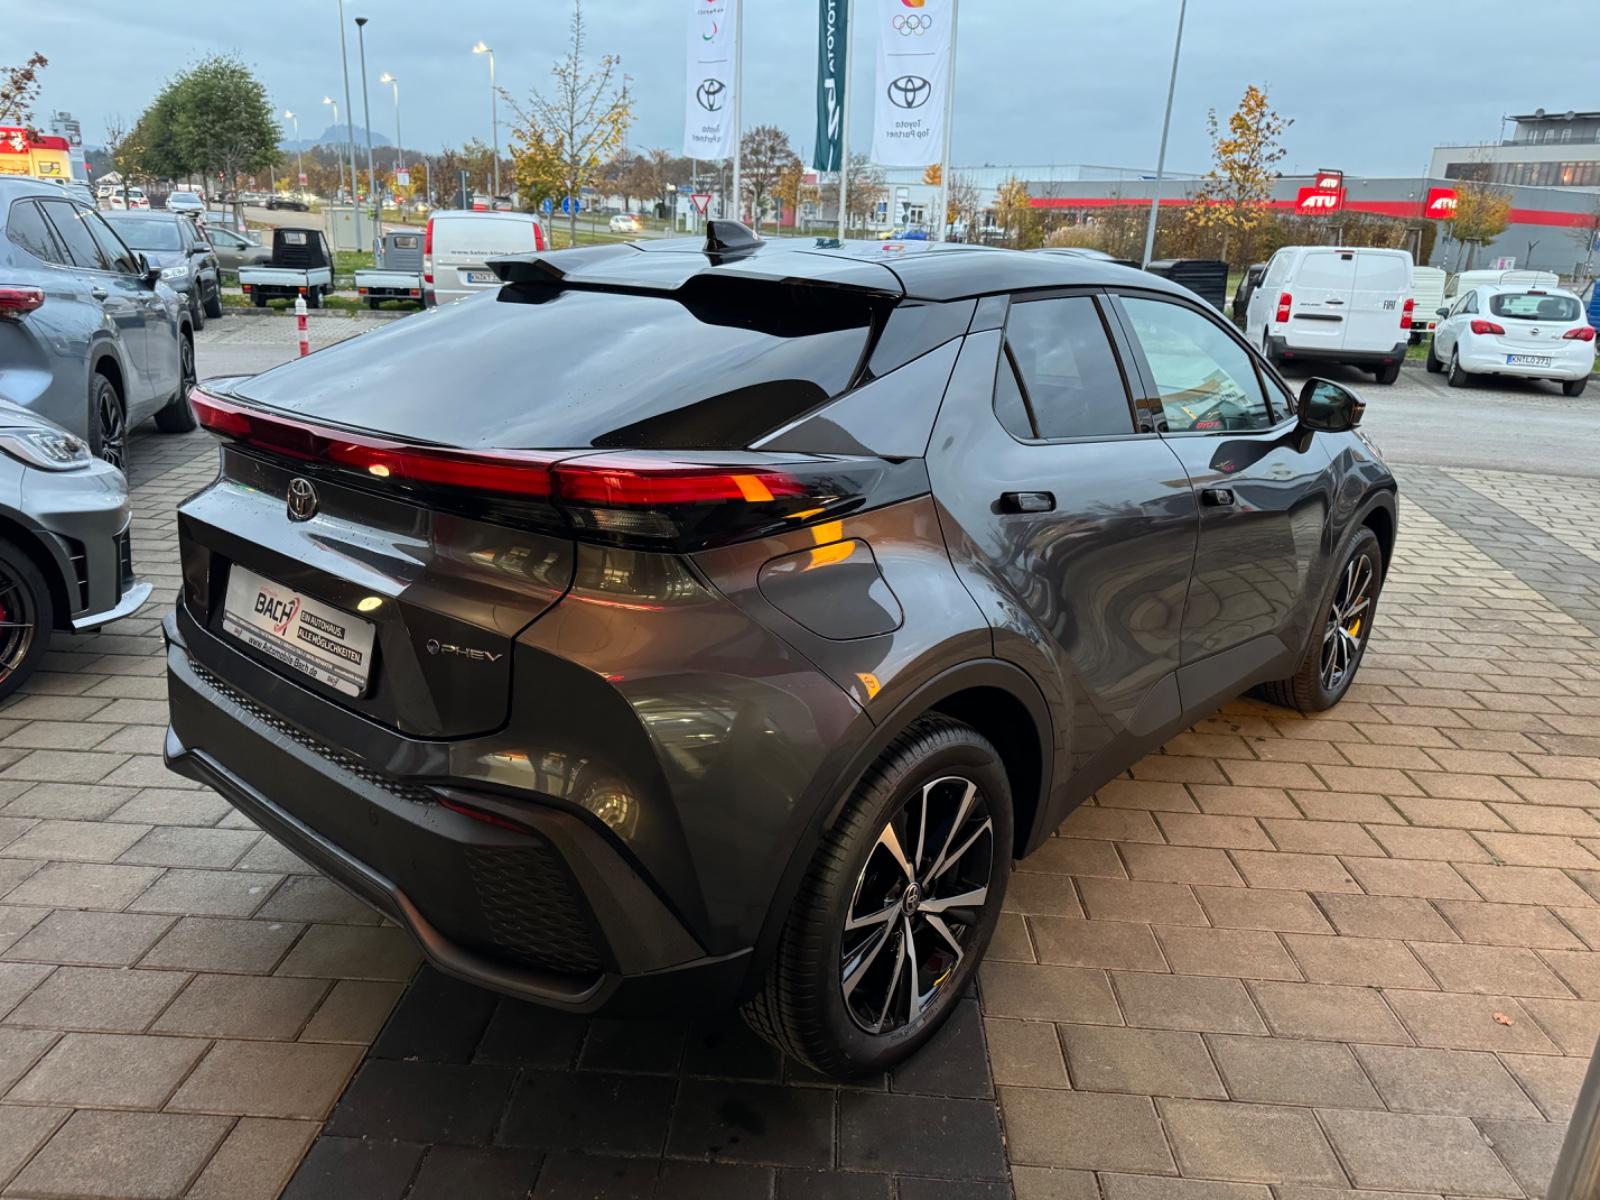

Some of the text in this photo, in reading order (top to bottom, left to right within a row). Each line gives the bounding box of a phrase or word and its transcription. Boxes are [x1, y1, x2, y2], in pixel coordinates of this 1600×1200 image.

[1301, 195, 1337, 207] ATU
[1383, 299, 1397, 310] FIAT
[1512, 355, 1521, 363] KN
[254, 592, 294, 625] BACH
[301, 611, 311, 623] EIN
[298, 627, 313, 641] ALLE
[440, 644, 503, 661] PHEV
